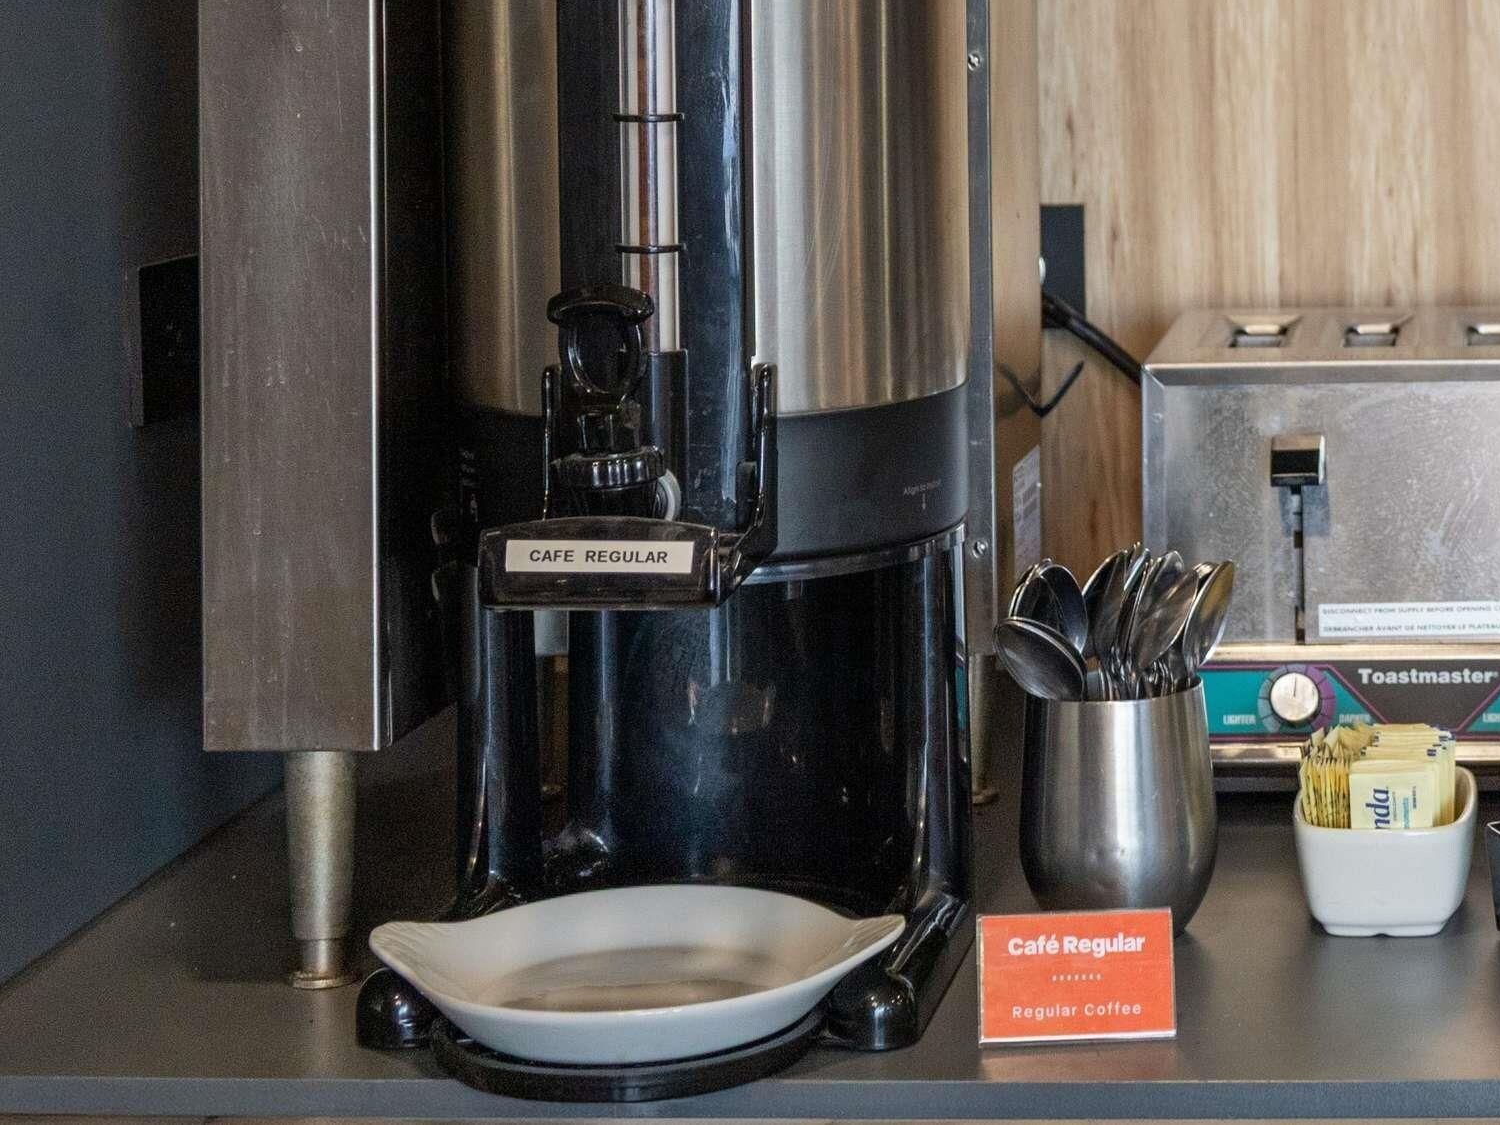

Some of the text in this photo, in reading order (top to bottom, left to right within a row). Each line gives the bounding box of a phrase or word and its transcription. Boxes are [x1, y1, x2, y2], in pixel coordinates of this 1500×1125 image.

[529, 549, 668, 564] CAFE REGULAR
[1357, 667, 1493, 685] Toastmaster
[1222, 714, 1257, 726] LIGHTER
[1365, 787, 1391, 829] nda
[1007, 931, 1147, 958] Café Regular
[1011, 1000, 1143, 1021] Regular Coffee
